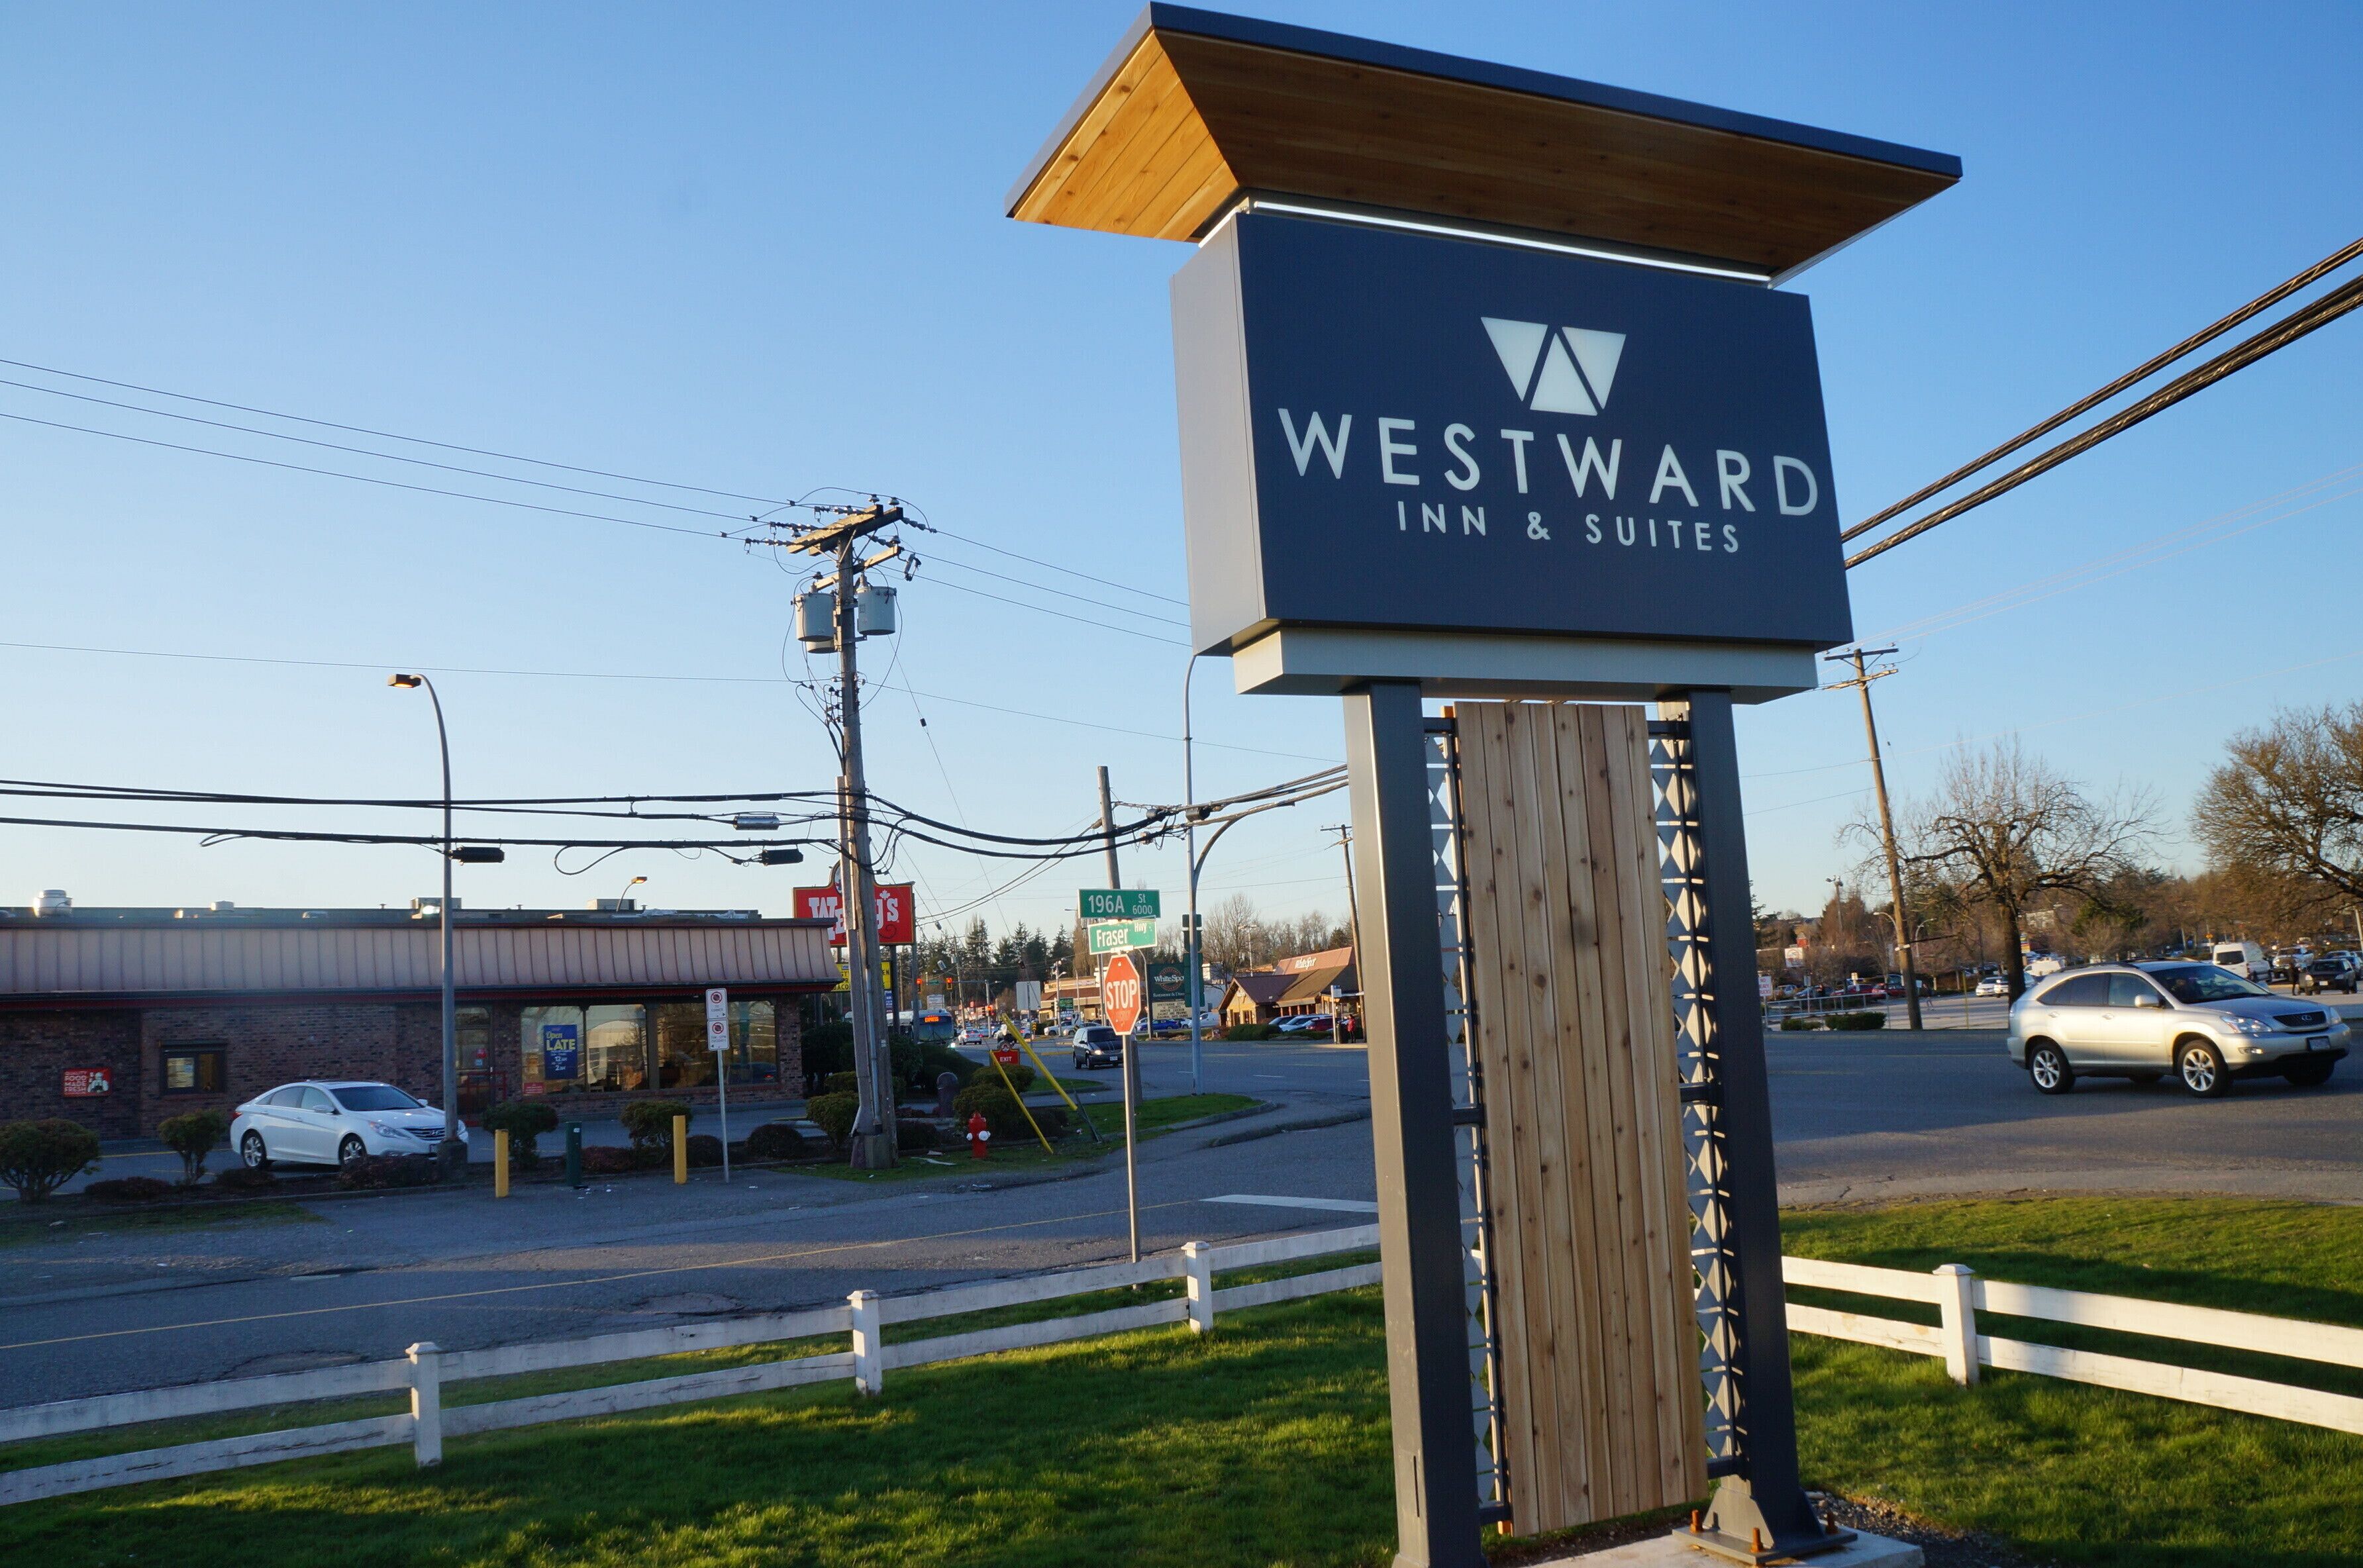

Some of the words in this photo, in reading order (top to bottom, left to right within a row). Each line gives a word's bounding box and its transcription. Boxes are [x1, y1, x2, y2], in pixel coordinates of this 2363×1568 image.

[1277, 407, 1819, 516] WESTWARD
[1397, 501, 1486, 536] INN
[1527, 511, 1551, 540] &
[1585, 513, 1739, 554] SUITES
[1088, 895, 1125, 913] 196A
[1138, 893, 1146, 903] St
[1132, 905, 1153, 914] 6000
[1134, 921, 1147, 934] Hwy
[1096, 928, 1129, 948] Fraser
[1106, 979, 1137, 1010] STOP
[546, 1039, 576, 1051] LATE
